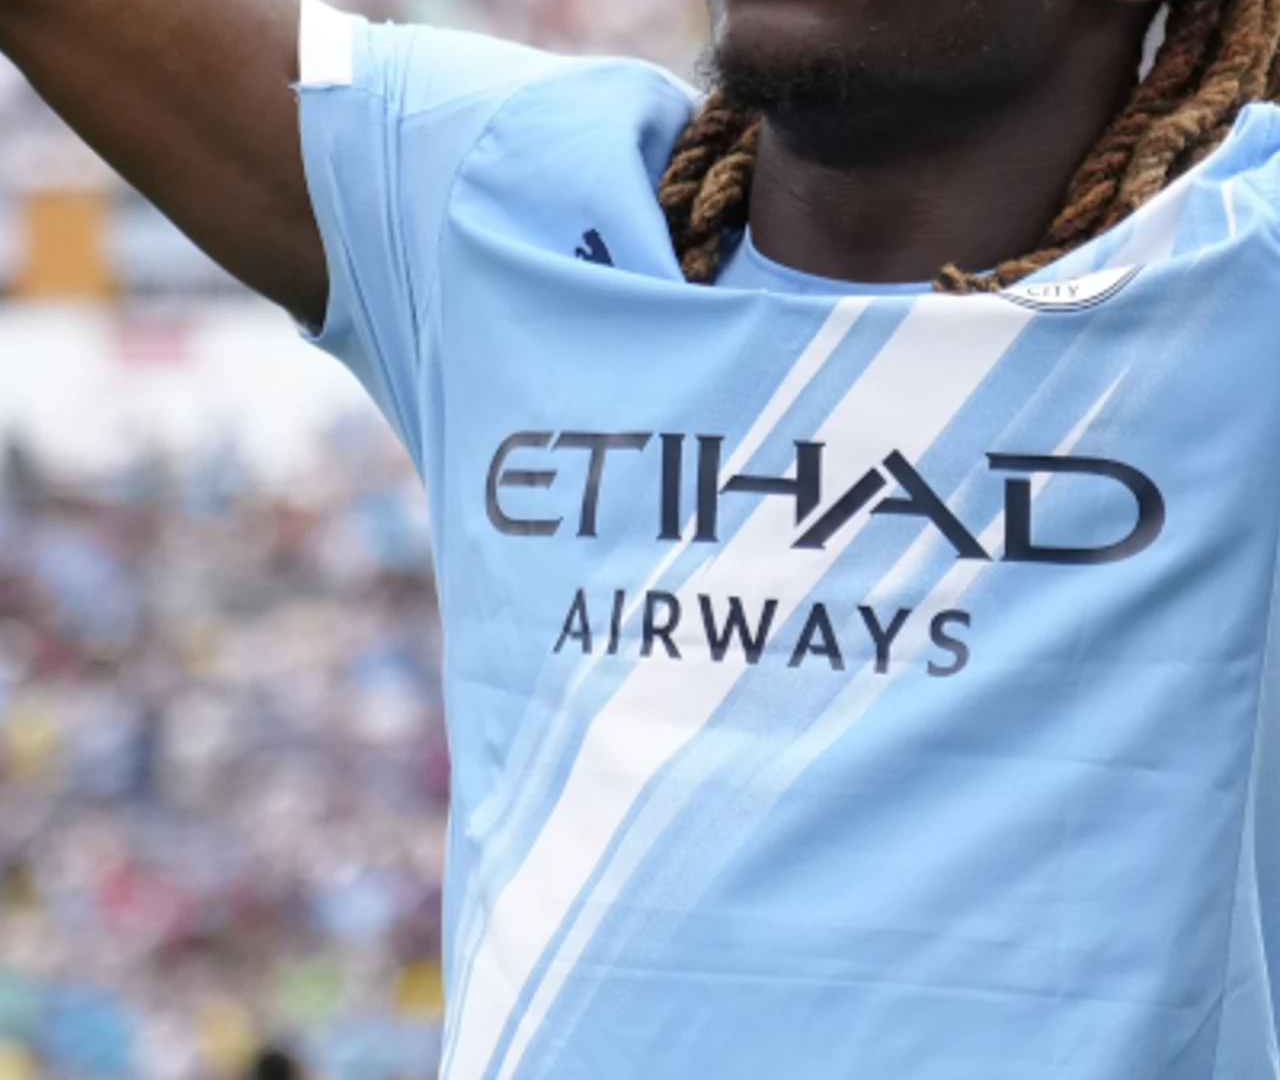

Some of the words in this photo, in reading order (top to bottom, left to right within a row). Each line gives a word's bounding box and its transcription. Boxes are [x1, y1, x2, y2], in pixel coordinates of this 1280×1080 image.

[1026, 284, 1082, 299] CITY
[484, 429, 1166, 565] ETIHAD
[553, 586, 972, 678] AIRWAYS
